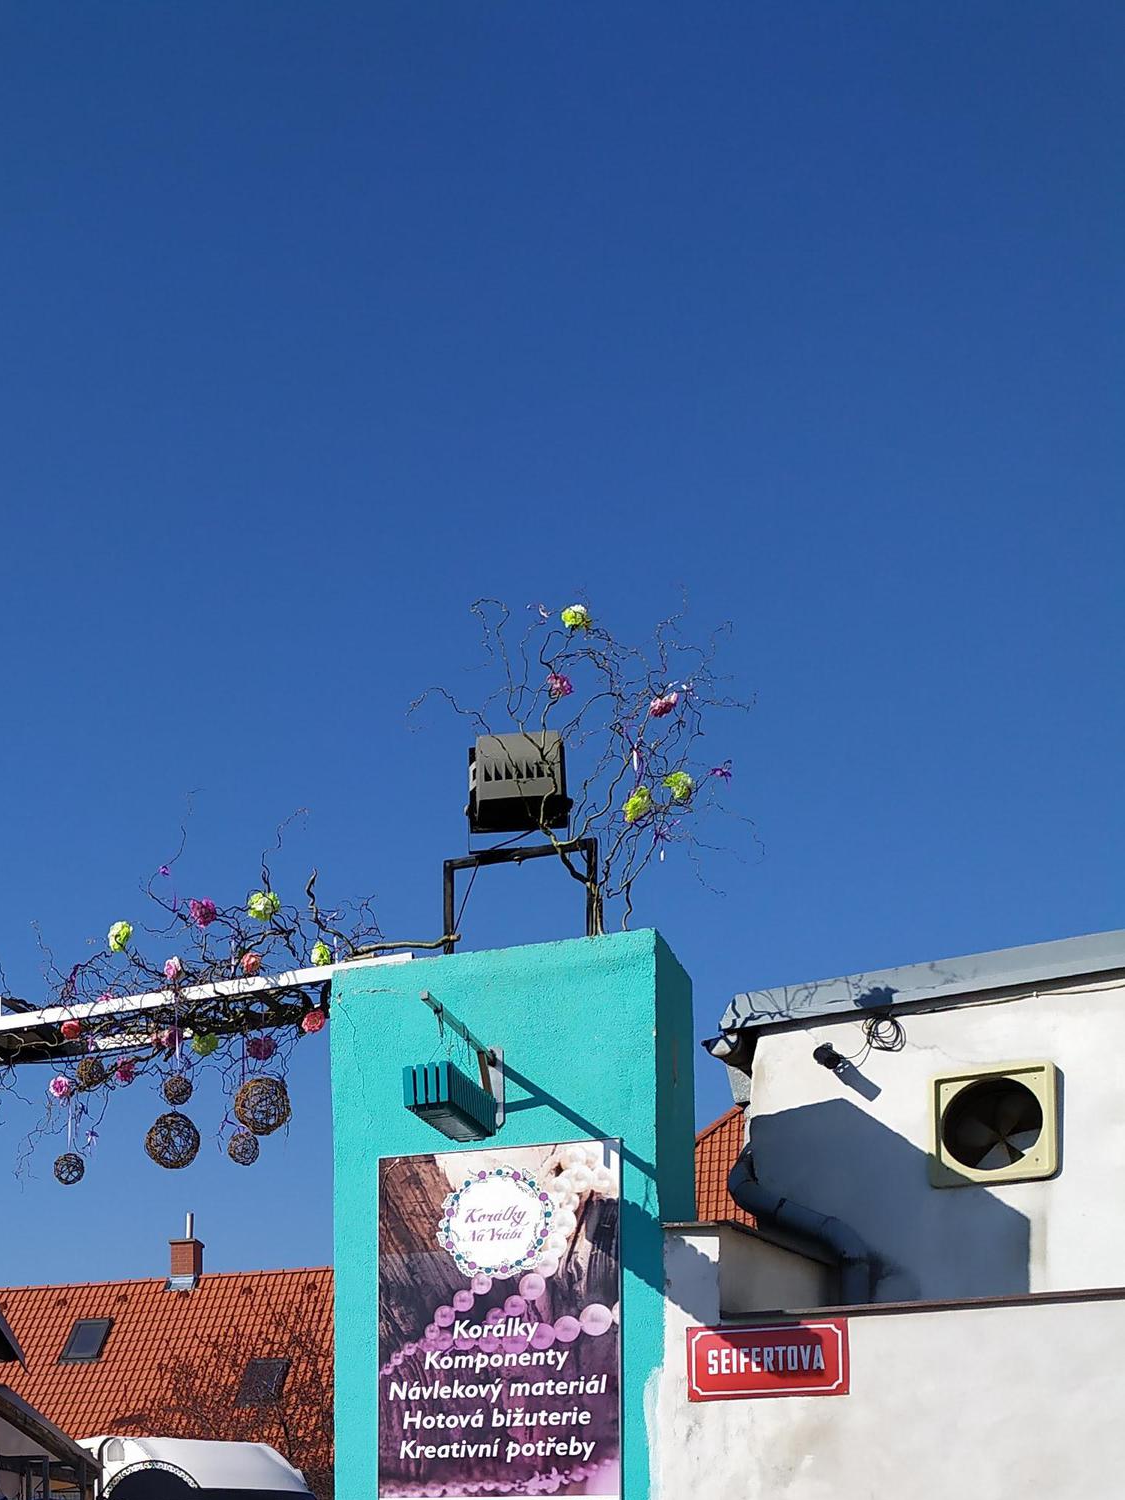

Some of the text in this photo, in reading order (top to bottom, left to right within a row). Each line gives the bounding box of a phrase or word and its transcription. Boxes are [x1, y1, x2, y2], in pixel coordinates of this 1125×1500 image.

[463, 1205, 530, 1227] Korálky
[463, 1228, 485, 1242] Na
[453, 1317, 539, 1342] Korálky
[425, 1349, 569, 1374] Komponenty
[707, 1344, 825, 1375] SEIFERTOVA
[389, 1374, 608, 1403] Návlekový materiál
[402, 1407, 592, 1430] Hotová bižuterie
[400, 1436, 596, 1463] Kreativní potřeby
